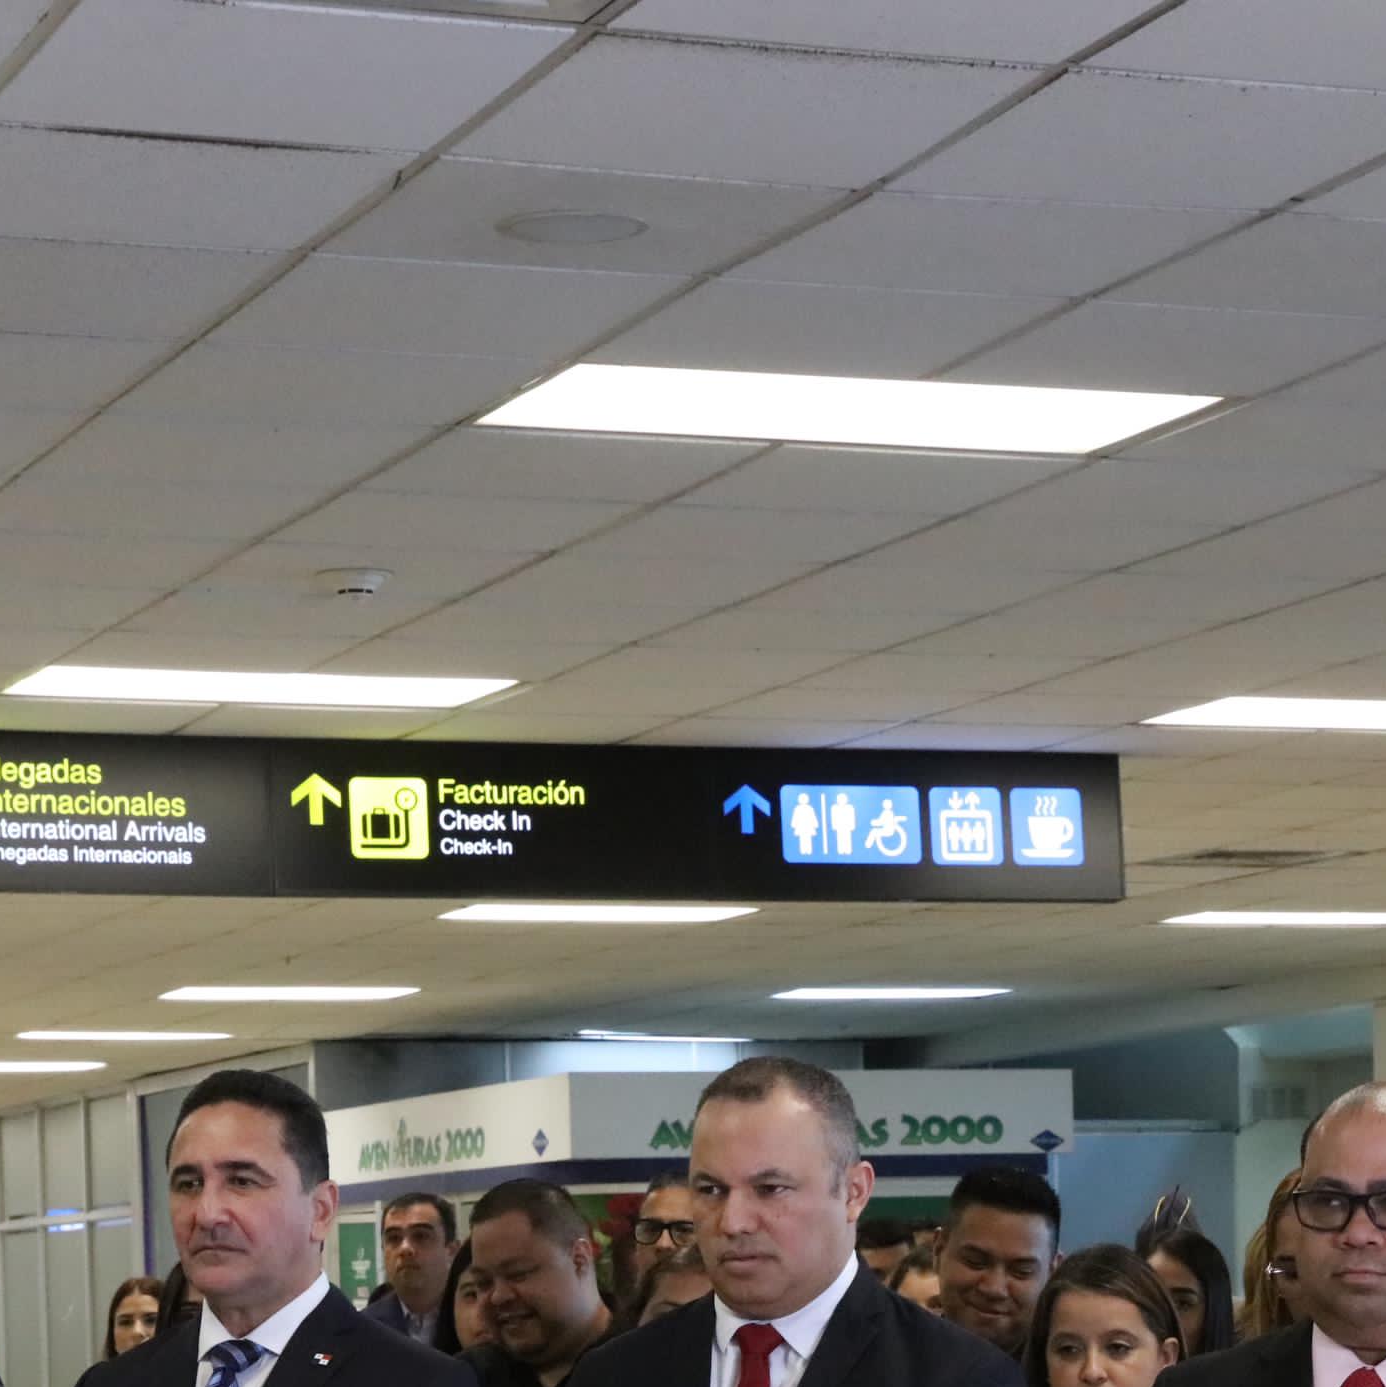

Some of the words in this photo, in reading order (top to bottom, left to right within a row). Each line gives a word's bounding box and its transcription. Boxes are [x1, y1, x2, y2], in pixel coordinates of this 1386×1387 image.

[437, 778, 586, 806] Facturación
[123, 819, 207, 844] Arrivals
[438, 808, 506, 832] Check
[510, 810, 532, 832] In
[72, 846, 193, 865] Internacionais
[439, 837, 513, 856] Check-In
[900, 1113, 1004, 1146] 2000
[444, 1126, 486, 1162] 2000
